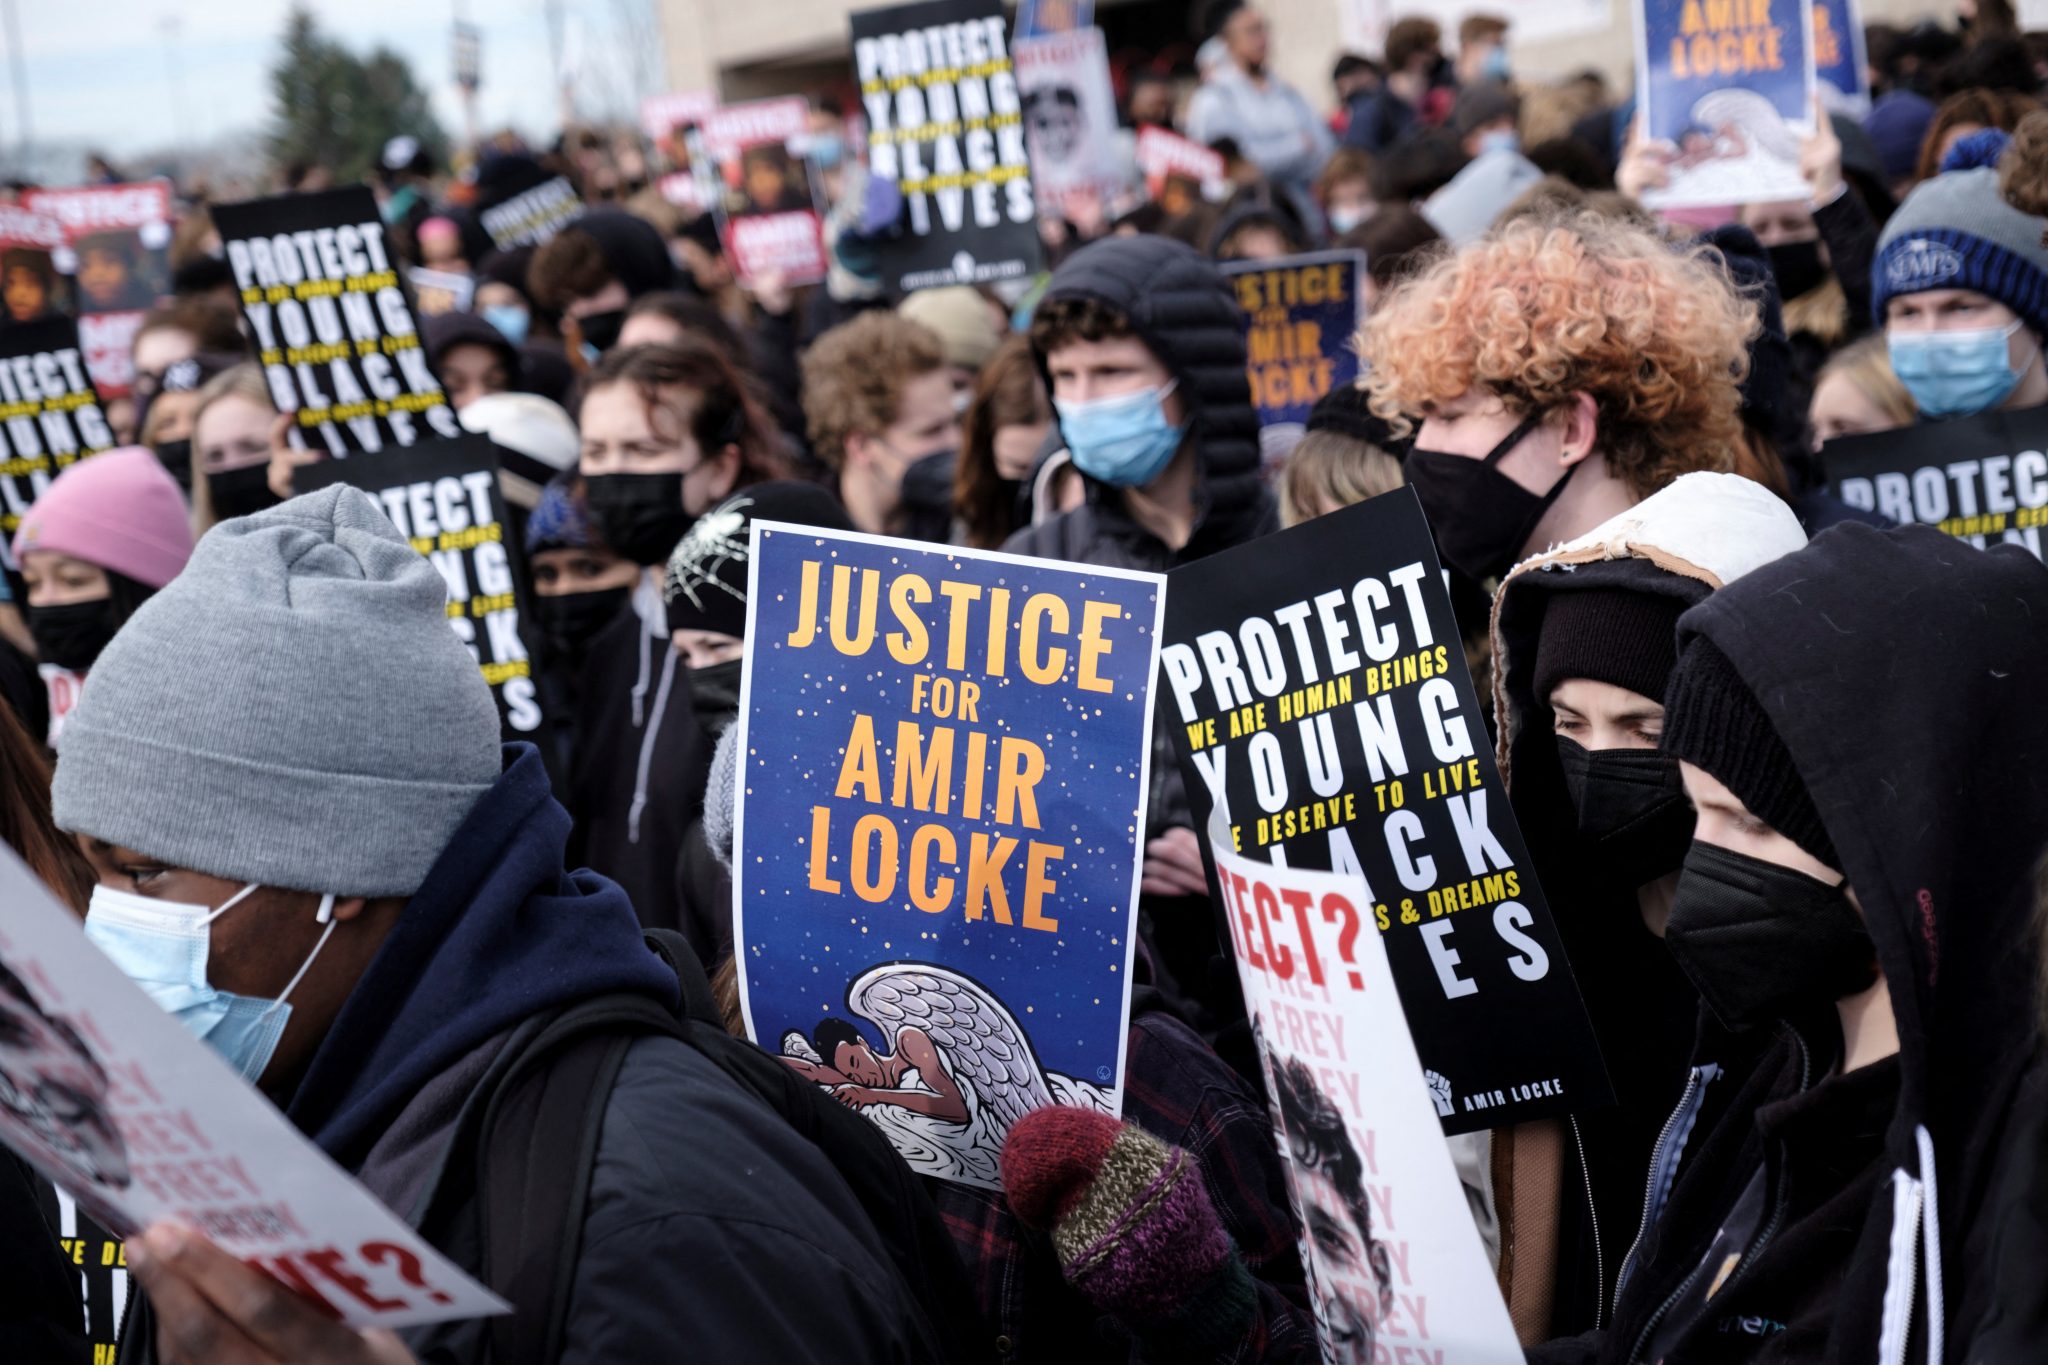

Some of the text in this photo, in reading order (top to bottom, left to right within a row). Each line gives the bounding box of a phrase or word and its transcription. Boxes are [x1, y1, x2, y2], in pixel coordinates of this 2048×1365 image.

[1670, 27, 1785, 79] LOCKE
[863, 71, 1021, 131] YOUNG
[908, 177, 1035, 236] IVES
[226, 221, 389, 291] PROTECT
[1235, 262, 1346, 312] STICE
[244, 286, 417, 357] YOUNG
[265, 349, 444, 413] BLACK
[1840, 449, 2048, 524] PROTEC
[788, 560, 1122, 694] JUSTICE
[1161, 561, 1434, 723] PROTECT
[911, 673, 981, 723] FOR
[1187, 645, 1449, 751] WE ARE HUMAN BEINGS
[834, 714, 1045, 830] AMIR
[1191, 678, 1475, 825] YOUNG
[1257, 792, 1357, 845] DESERVE
[1374, 780, 1404, 812] TO
[1423, 758, 1482, 800] LIVE
[808, 805, 1065, 933] LOCKE
[1427, 870, 1521, 918] DREAMS
[1270, 1000, 1347, 1062] FREY
[1463, 1077, 1564, 1113] AMIR LOCKE
[131, 1157, 261, 1203] FREY
